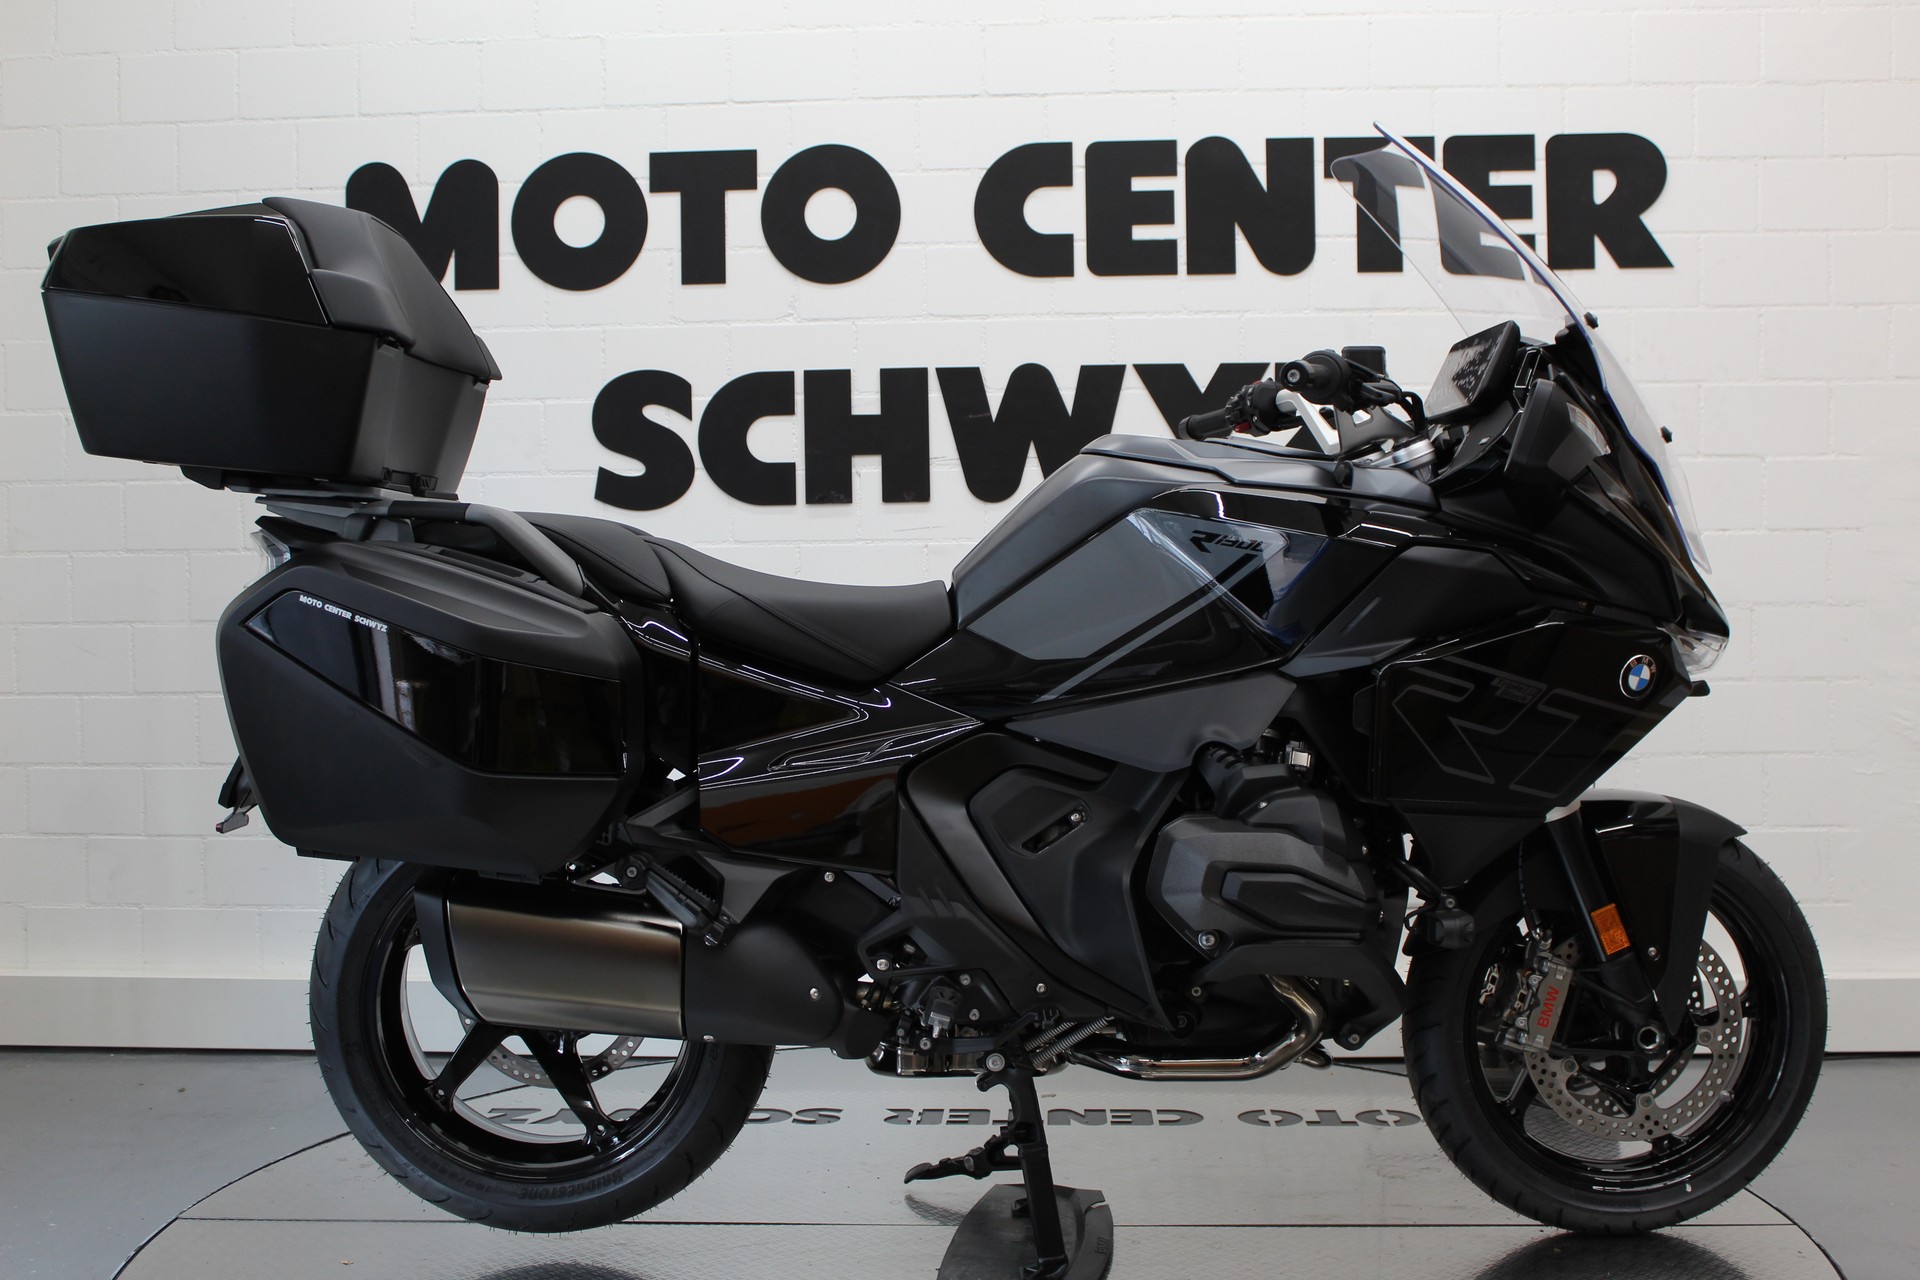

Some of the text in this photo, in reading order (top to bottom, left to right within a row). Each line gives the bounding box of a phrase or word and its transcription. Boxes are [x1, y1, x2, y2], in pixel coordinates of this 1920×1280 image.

[346, 132, 1672, 290] MOTO CENTER
[299, 594, 387, 631] MOTO CENTER SCHWYZ
[1538, 986, 1560, 1027] BMW
[485, 1107, 1421, 1127] OTO CENER SCYZ
[517, 1171, 624, 1200] BRIDGESTONE
